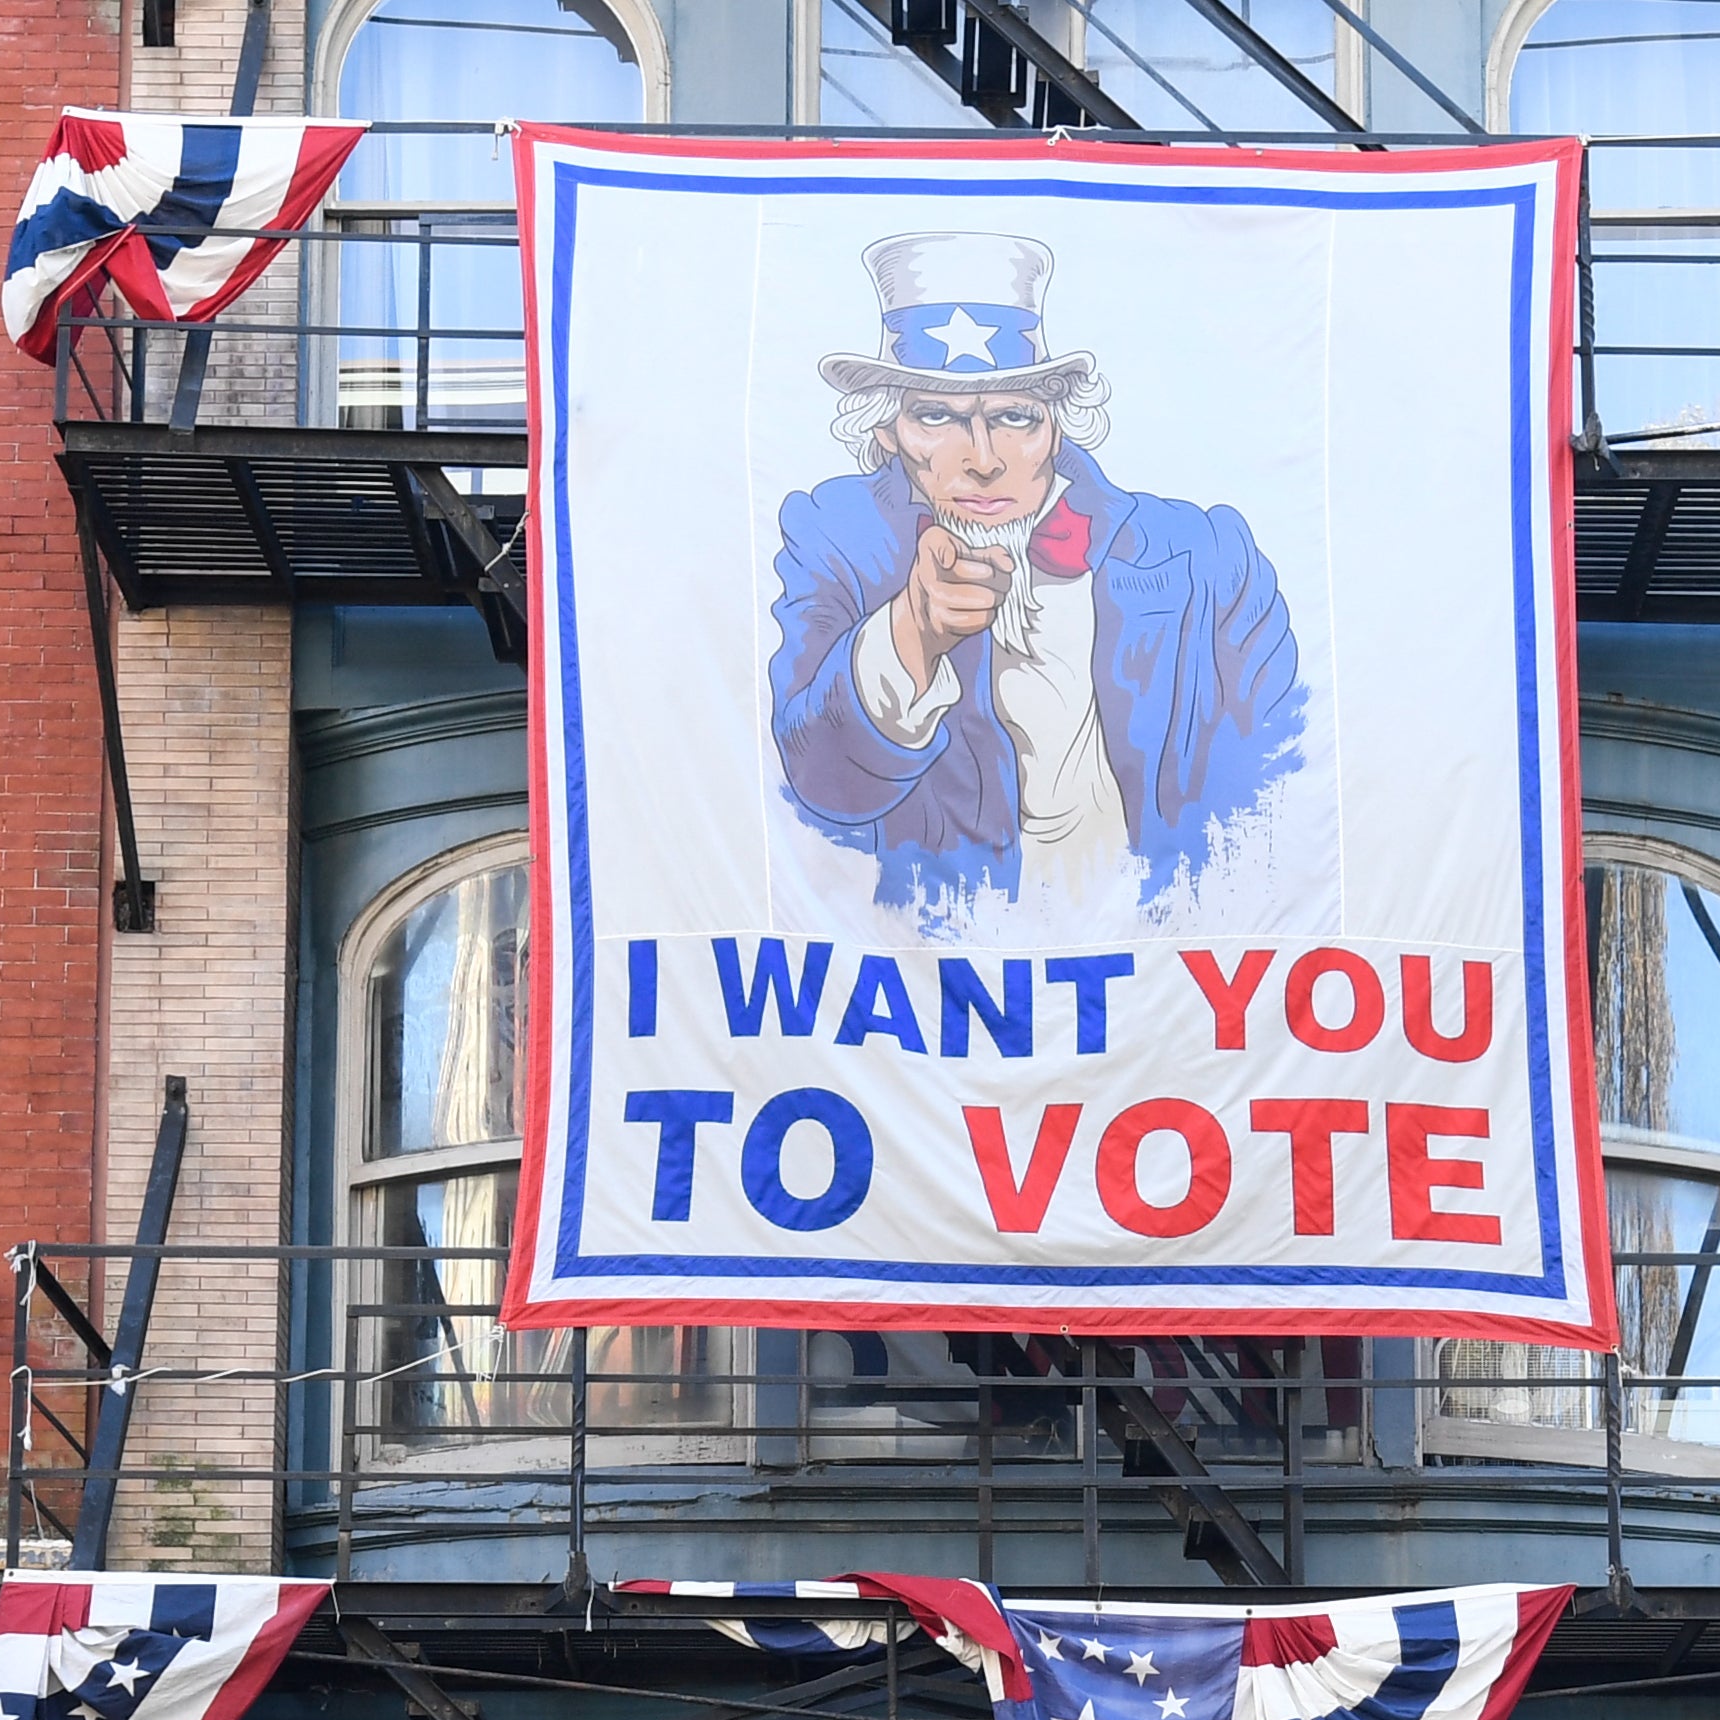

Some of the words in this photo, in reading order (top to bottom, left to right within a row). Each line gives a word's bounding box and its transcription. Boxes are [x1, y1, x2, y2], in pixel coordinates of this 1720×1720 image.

[627, 939, 657, 1037] I
[711, 936, 1134, 1058] WANT
[1178, 947, 1493, 1062] YOU
[624, 1086, 874, 1232] TO
[962, 1096, 1502, 1246] VOTE
